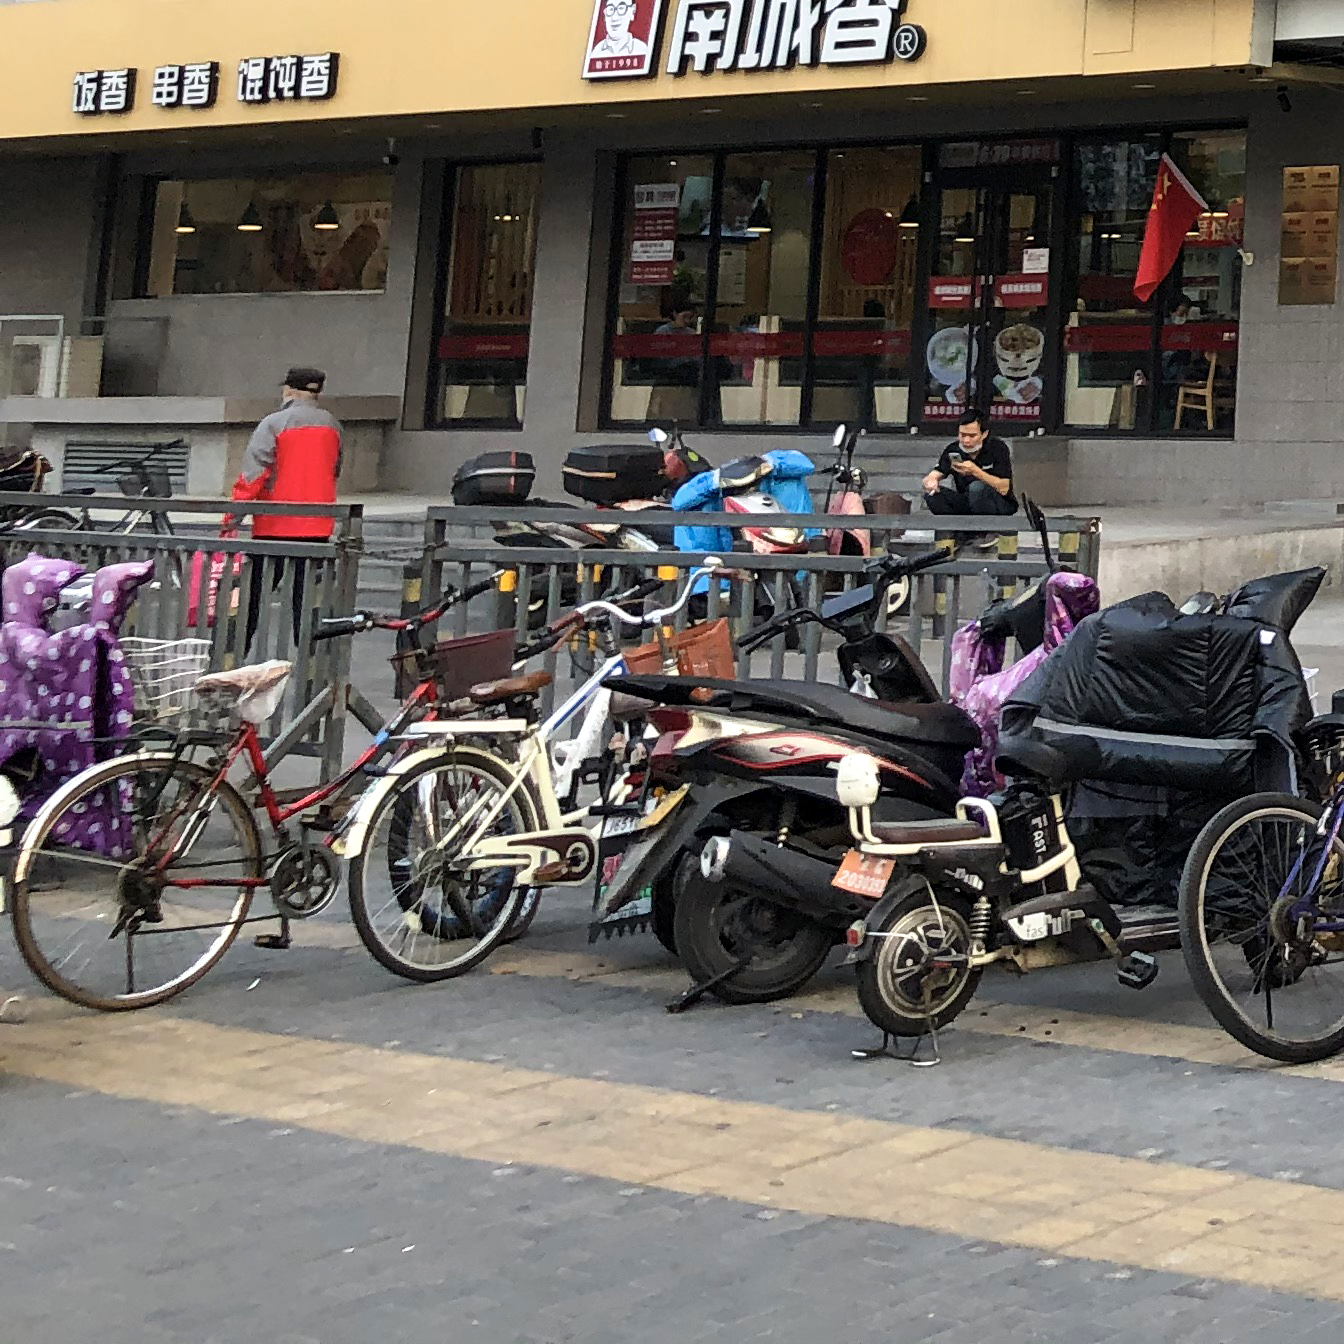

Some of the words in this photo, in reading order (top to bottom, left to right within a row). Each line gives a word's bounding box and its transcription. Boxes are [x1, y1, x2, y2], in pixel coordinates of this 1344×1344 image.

[72, 68, 132, 114] 饭香
[152, 61, 216, 107] 串香
[238, 52, 336, 103] 馄饨香
